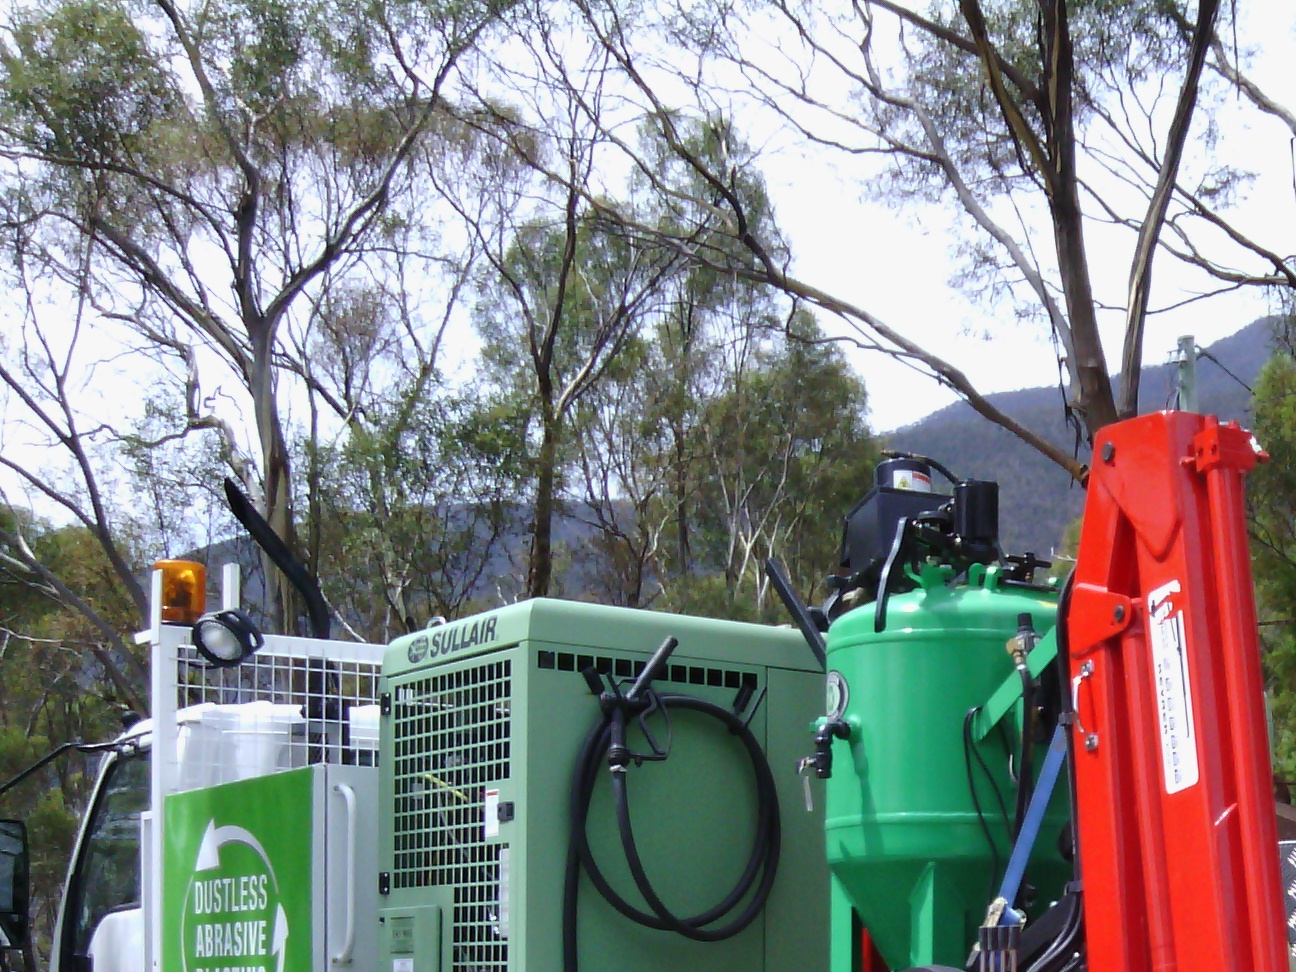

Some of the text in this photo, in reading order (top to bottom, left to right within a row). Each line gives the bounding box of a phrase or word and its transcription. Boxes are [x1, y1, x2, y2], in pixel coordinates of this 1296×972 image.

[429, 616, 498, 658] SULLAIR
[195, 874, 268, 914] DUSTLESS
[195, 920, 267, 958] ABRASIVE
